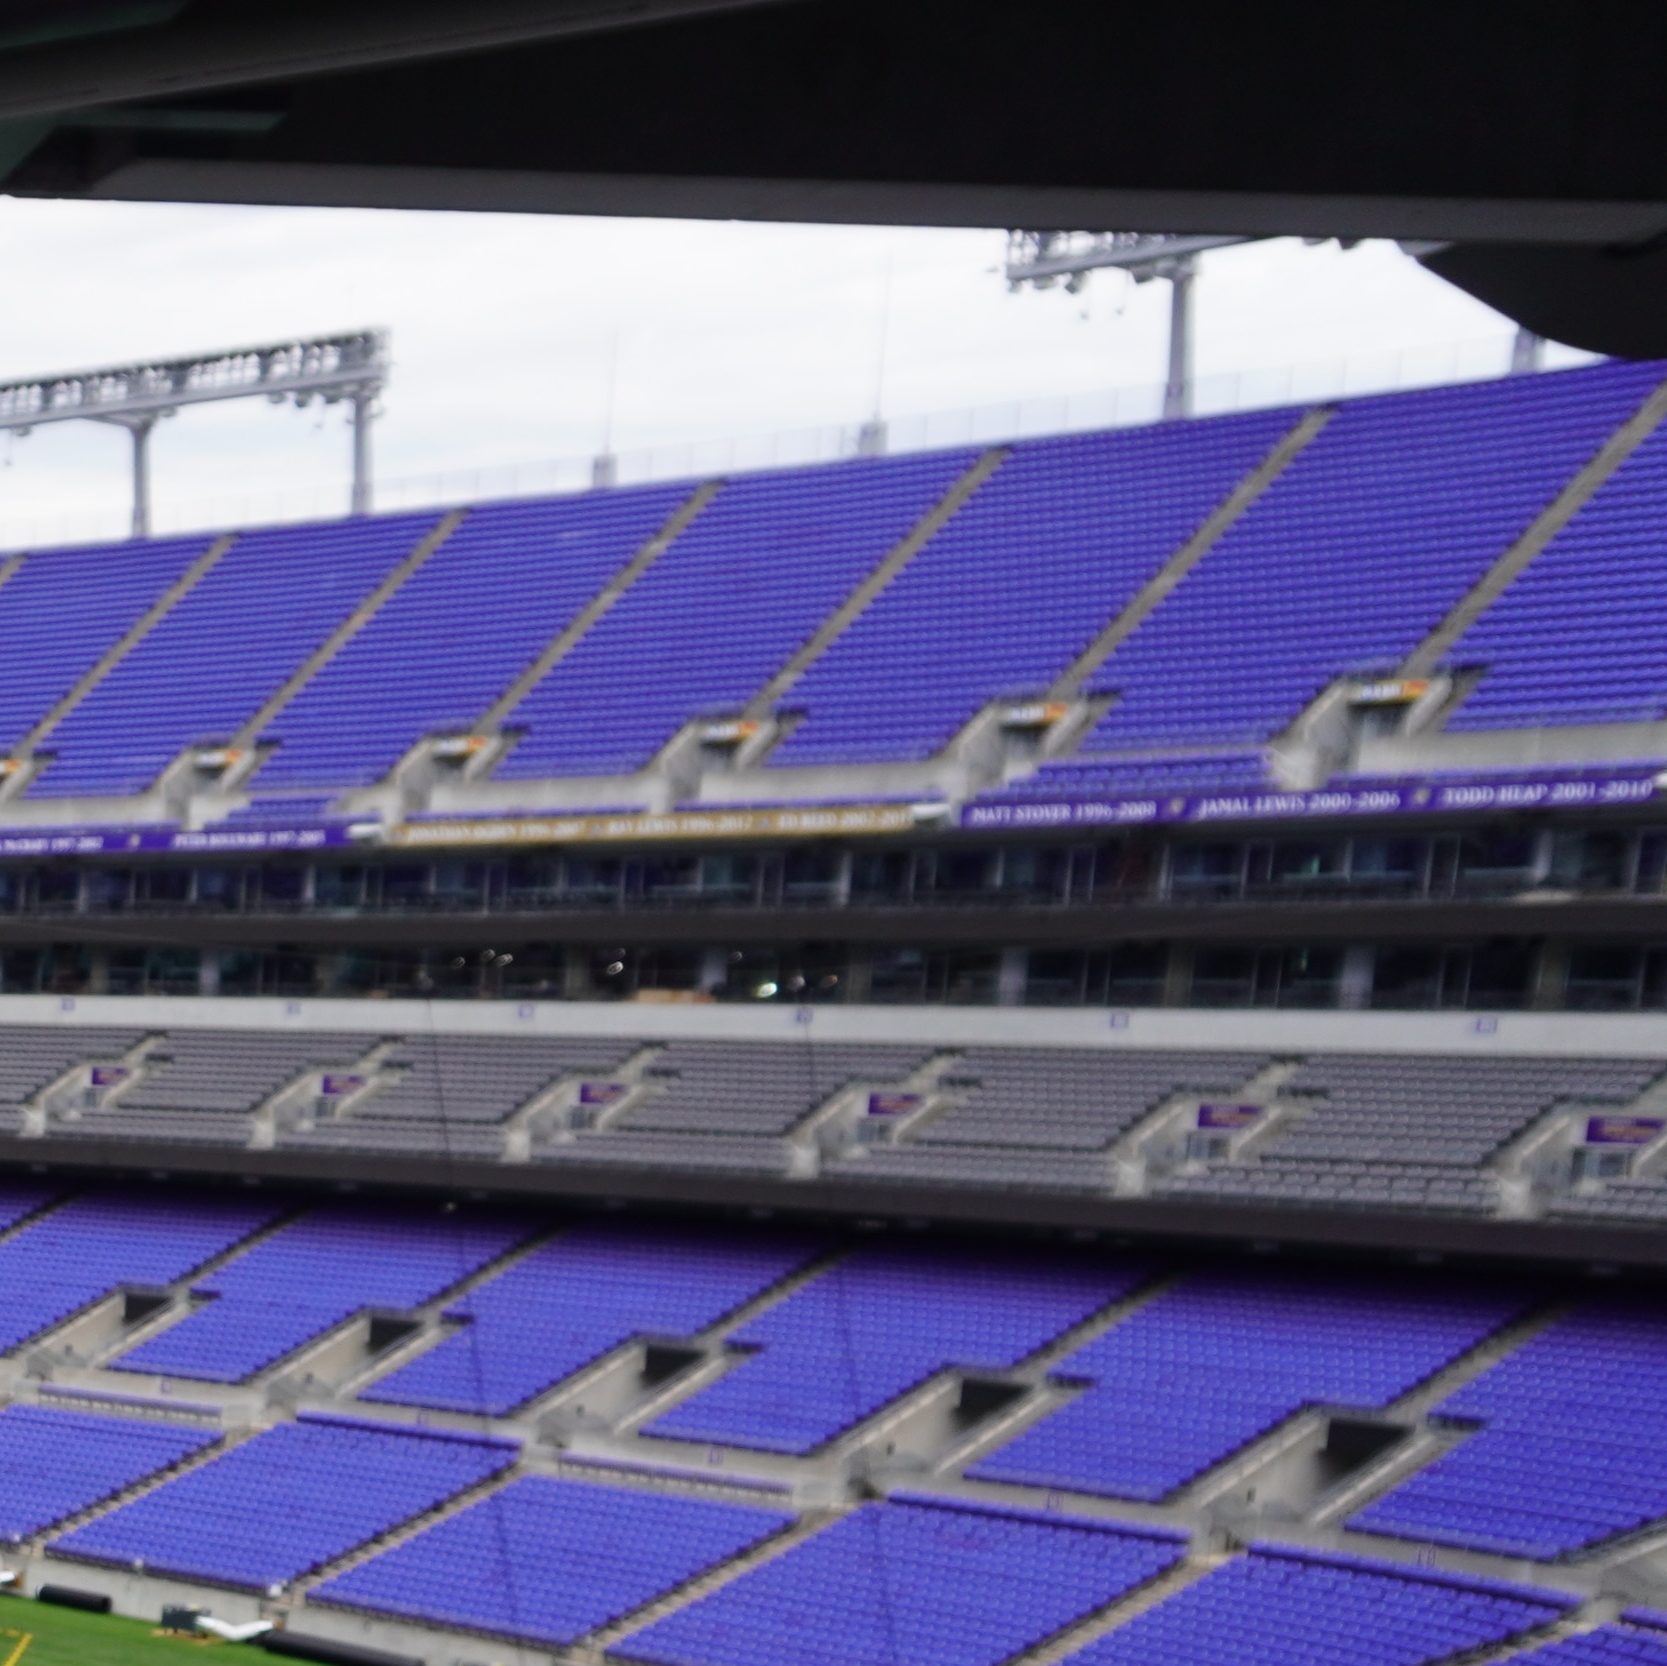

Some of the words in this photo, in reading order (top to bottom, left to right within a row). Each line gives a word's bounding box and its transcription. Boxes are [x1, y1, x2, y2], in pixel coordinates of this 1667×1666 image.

[1442, 785, 1494, 803] TODD
[1498, 783, 1547, 801] HEAP
[972, 805, 1013, 823] MATT
[1015, 803, 1071, 821] STOVER
[1199, 797, 1251, 819] JAMAL
[1255, 794, 1306, 813] LEWIS
